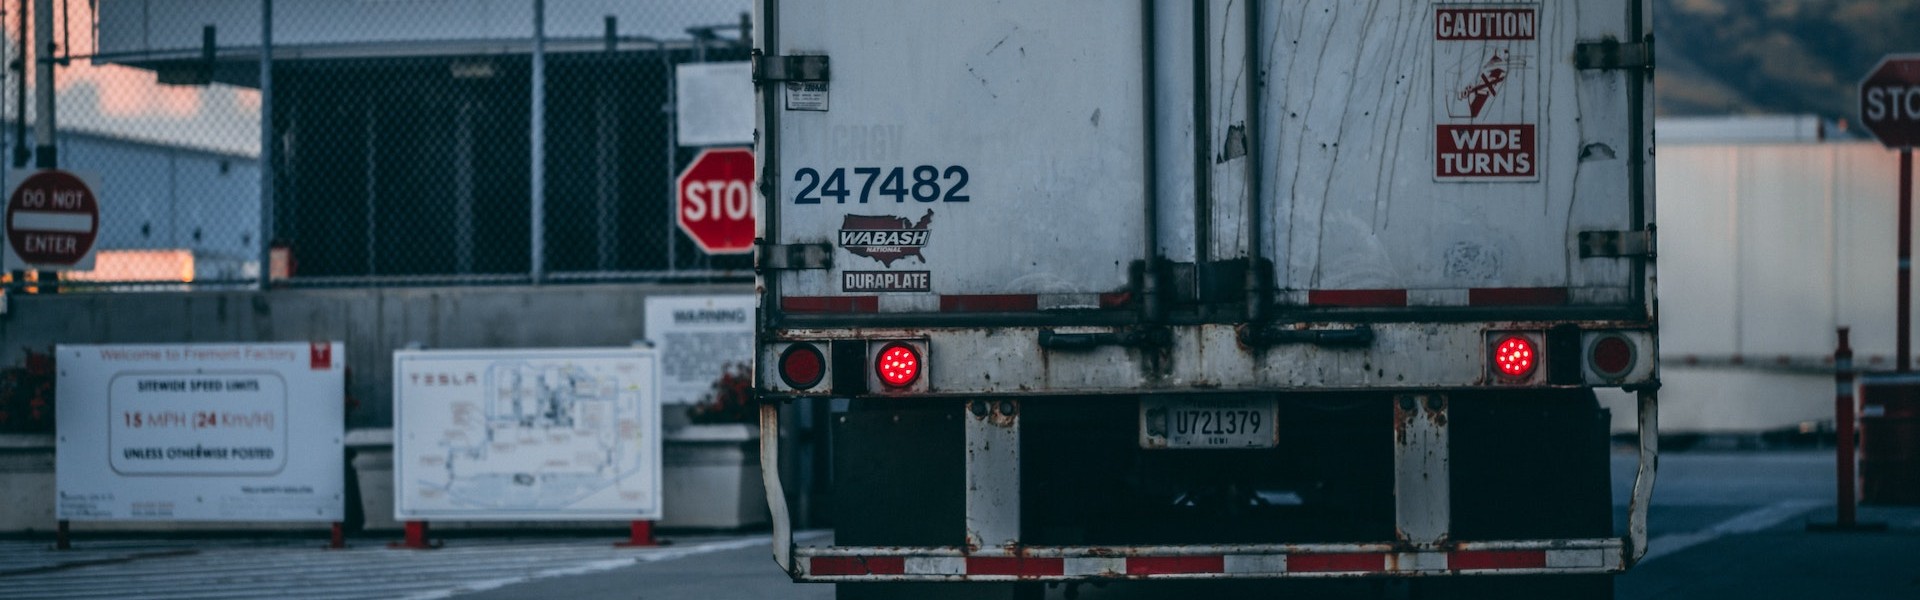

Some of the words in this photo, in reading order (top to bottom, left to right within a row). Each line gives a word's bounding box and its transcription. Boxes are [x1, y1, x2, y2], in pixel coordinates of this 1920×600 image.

[1438, 11, 1532, 37] CAUTION
[1450, 129, 1522, 150] WIDE
[1440, 153, 1531, 174] TURNS
[794, 165, 970, 205] 247482
[22, 189, 45, 208] DO
[53, 189, 84, 209] NOT
[684, 179, 755, 222] STO
[25, 235, 77, 254] ENTER
[840, 231, 928, 245] WABASH
[845, 273, 928, 290] DURAPLATE
[673, 309, 746, 323] WARNING
[102, 348, 162, 361] Welcome
[166, 349, 180, 361] to
[184, 348, 241, 361] Fremont
[244, 348, 296, 362] Factory
[138, 380, 187, 392] SITEWIDE
[190, 380, 222, 392] SPEED
[226, 380, 260, 392] LIMITS
[410, 373, 477, 386] TESLA
[125, 411, 143, 428] 15
[148, 412, 186, 427] MPH
[191, 411, 217, 430] (24
[222, 411, 275, 430] Km/H)
[1176, 411, 1261, 434] U721379
[124, 447, 163, 460] UNLESS
[167, 447, 228, 460] OTHERWISE
[232, 447, 274, 460] POSTED
